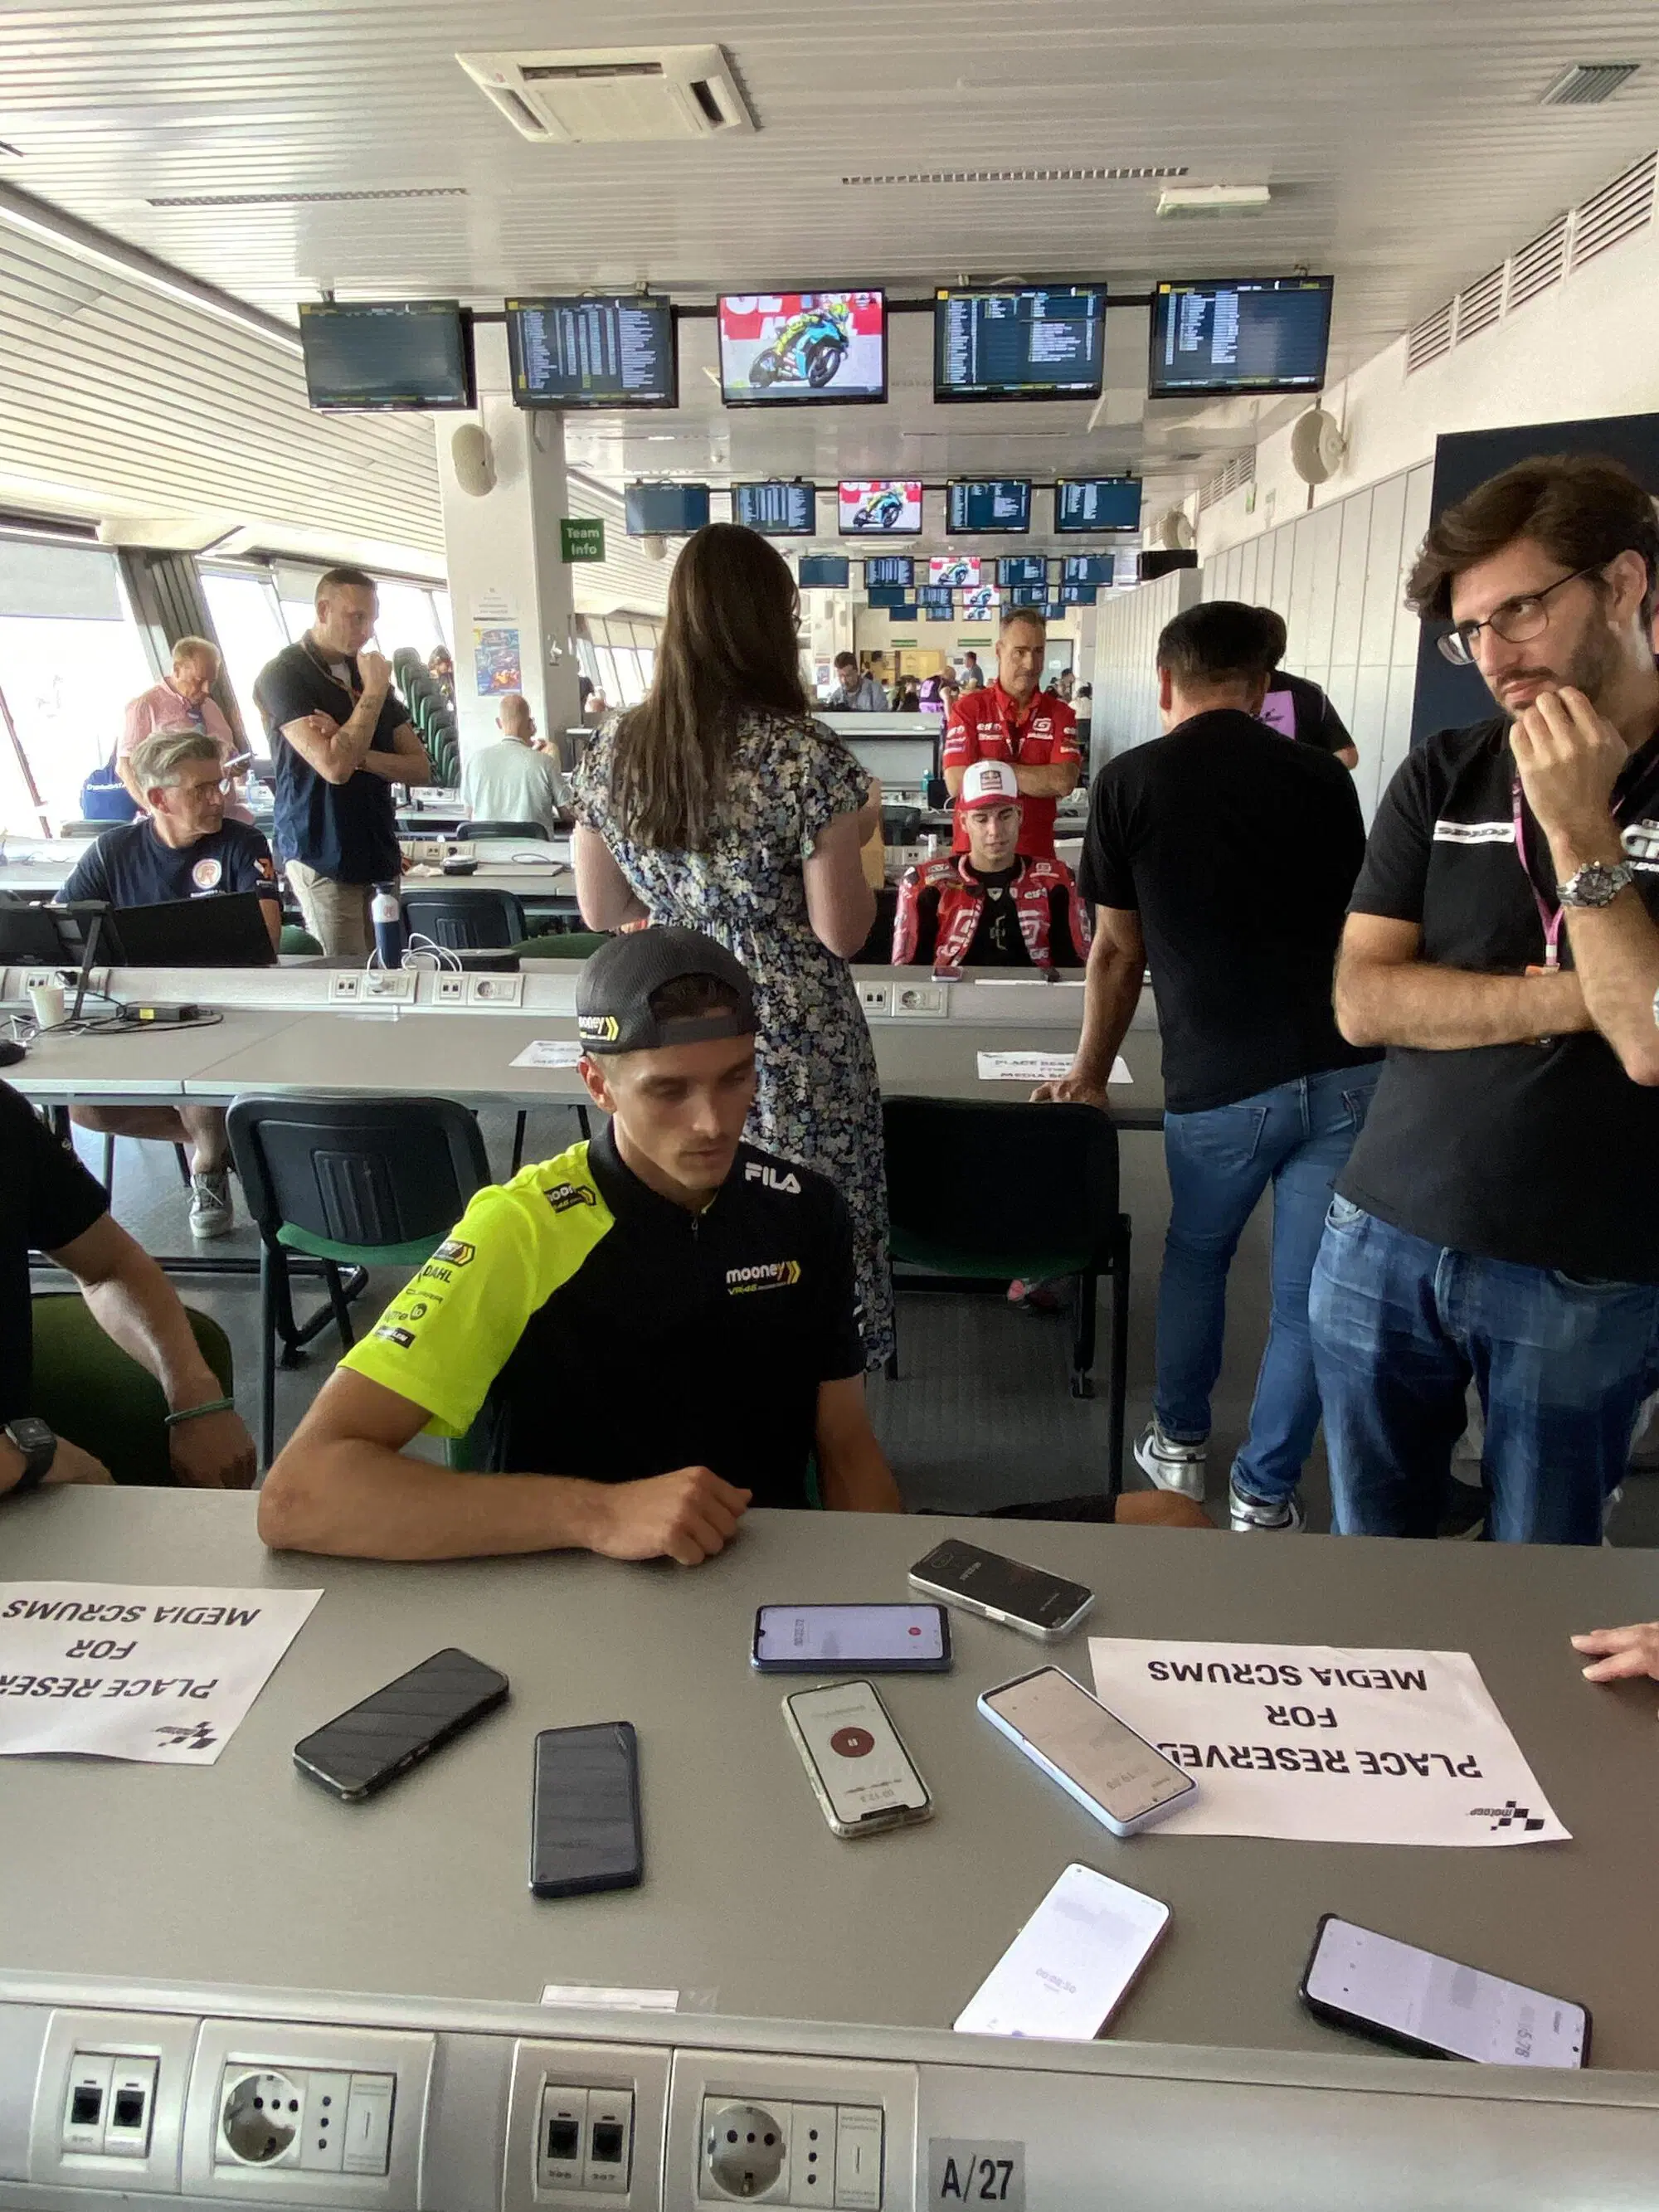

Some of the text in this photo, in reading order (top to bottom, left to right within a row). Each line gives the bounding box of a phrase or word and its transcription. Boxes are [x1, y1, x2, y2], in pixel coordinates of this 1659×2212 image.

[566, 527, 601, 539] Team
[571, 542, 597, 556] Info
[744, 1161, 802, 1194] FILA
[726, 1261, 786, 1284] mooney
[2, 1599, 262, 1627] MEDIA SCRUMS
[66, 1639, 139, 1660] FOR
[1147, 1660, 1428, 1692] MEDIA SCRUMS
[105, 1678, 219, 1699] PLACE
[1267, 1704, 1338, 1728] FOR
[1355, 1750, 1483, 1778] PLACE
[940, 2157, 1014, 2201] A/27
